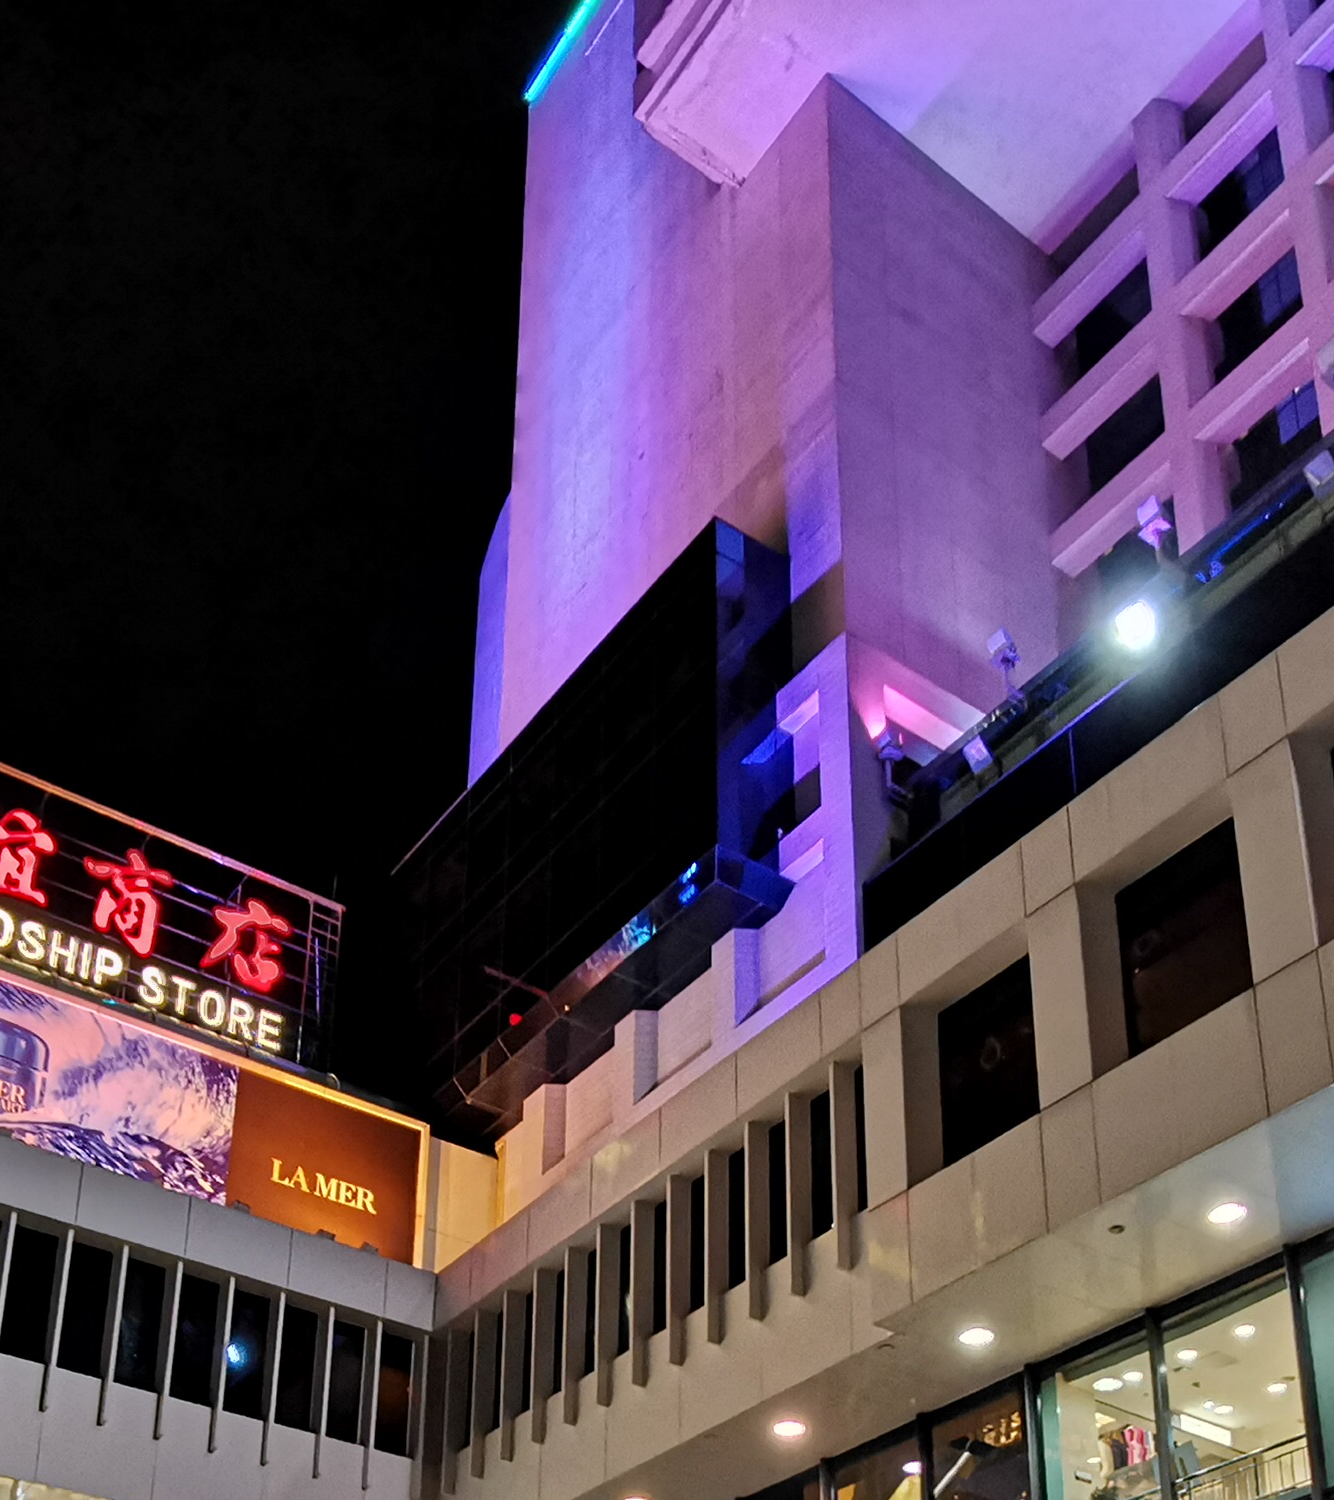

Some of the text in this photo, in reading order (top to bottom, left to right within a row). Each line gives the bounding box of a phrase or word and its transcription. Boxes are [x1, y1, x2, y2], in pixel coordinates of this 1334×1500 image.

[137, 966, 284, 1053] STORE
[271, 1158, 378, 1215] LA MER
